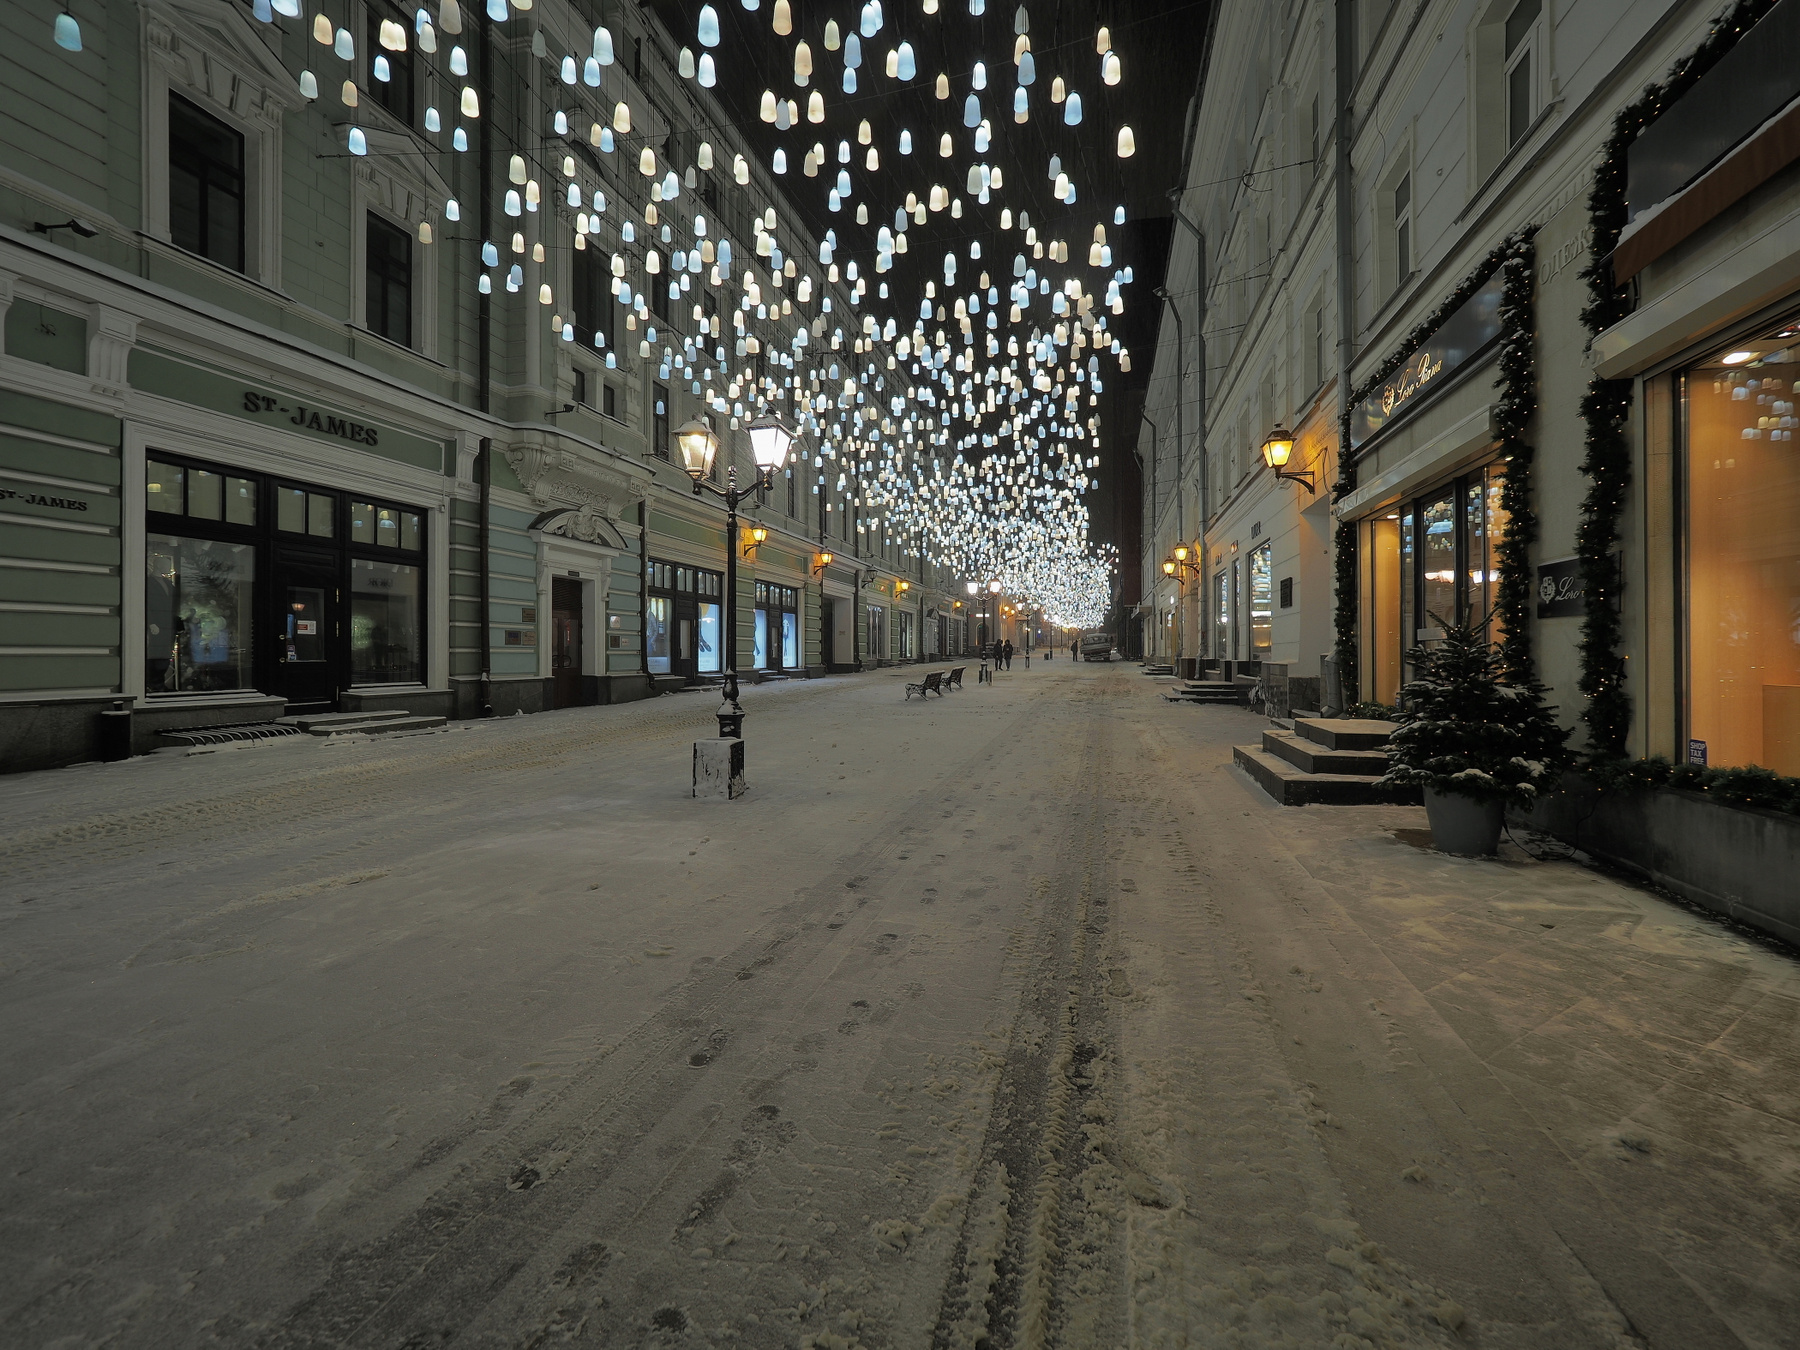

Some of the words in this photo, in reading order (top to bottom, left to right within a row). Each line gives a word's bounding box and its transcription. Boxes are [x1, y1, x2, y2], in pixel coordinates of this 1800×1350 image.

[1555, 576, 1581, 601] Loro
[1690, 741, 1706, 751] SHOP
[1690, 749, 1703, 758] TAX
[1690, 757, 1705, 765] FREE
